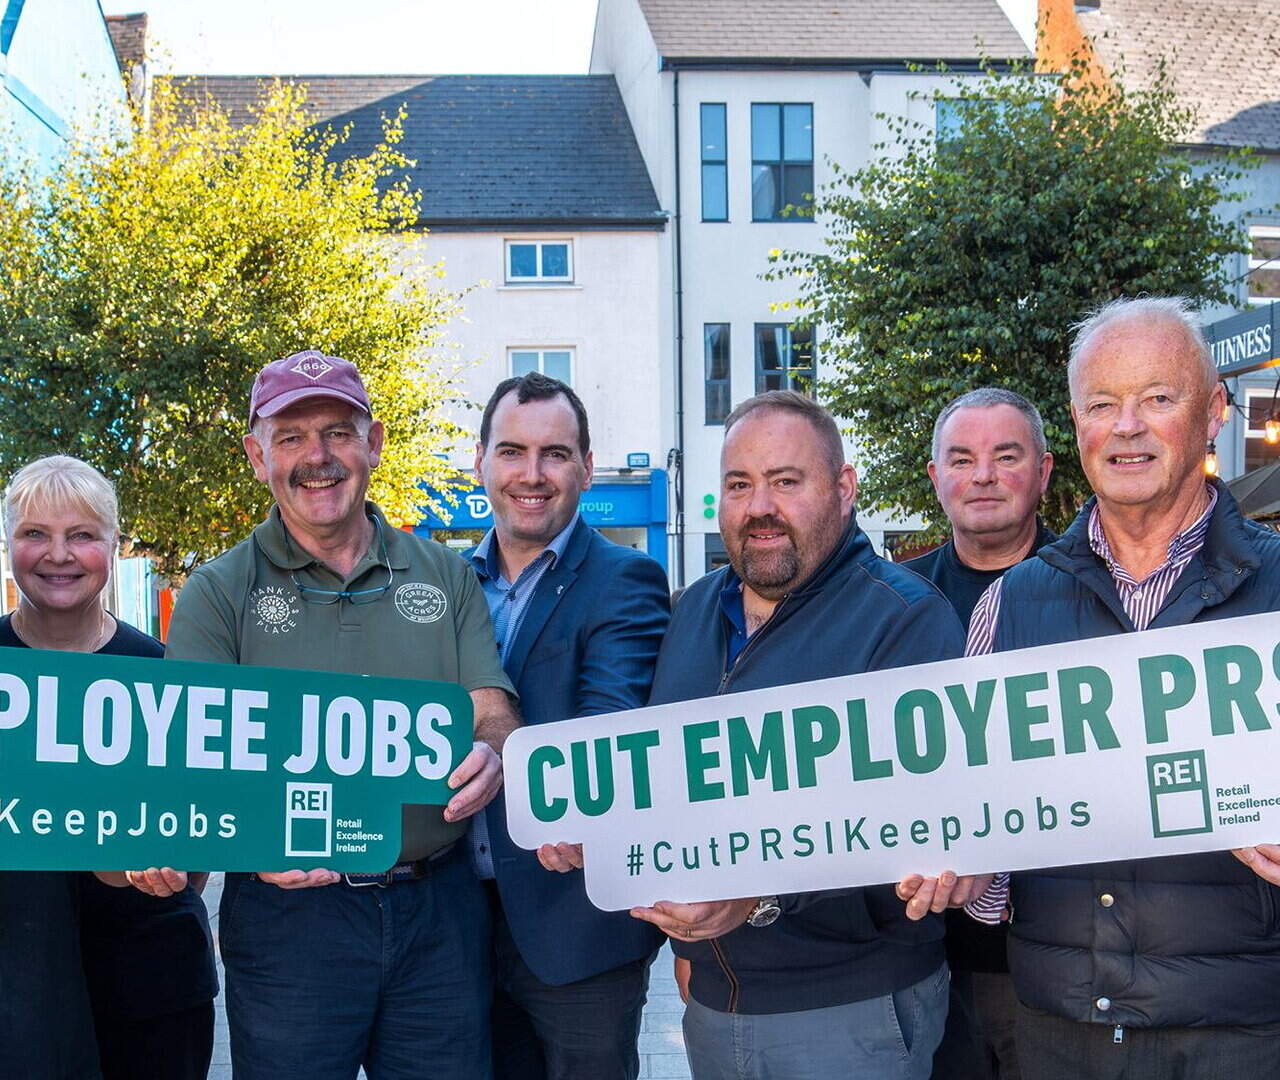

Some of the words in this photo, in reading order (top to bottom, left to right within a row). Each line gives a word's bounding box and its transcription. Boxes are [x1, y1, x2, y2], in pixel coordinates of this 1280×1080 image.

[1206, 323, 1272, 369] UINNESS
[579, 502, 614, 515] roup
[256, 619, 297, 635] PLACE
[283, 694, 454, 780] JOBS
[527, 728, 661, 823] CUT
[682, 665, 1122, 804] EMPLOYER
[1152, 758, 1202, 787] REI
[1216, 784, 1251, 798] Retail
[291, 790, 328, 811] REI
[336, 819, 362, 828] Retail
[1219, 812, 1260, 826] Ireland
[336, 831, 383, 841] Excellence
[626, 796, 1091, 877] #CutPRSIKeepJobs
[336, 843, 367, 852] Ireland
